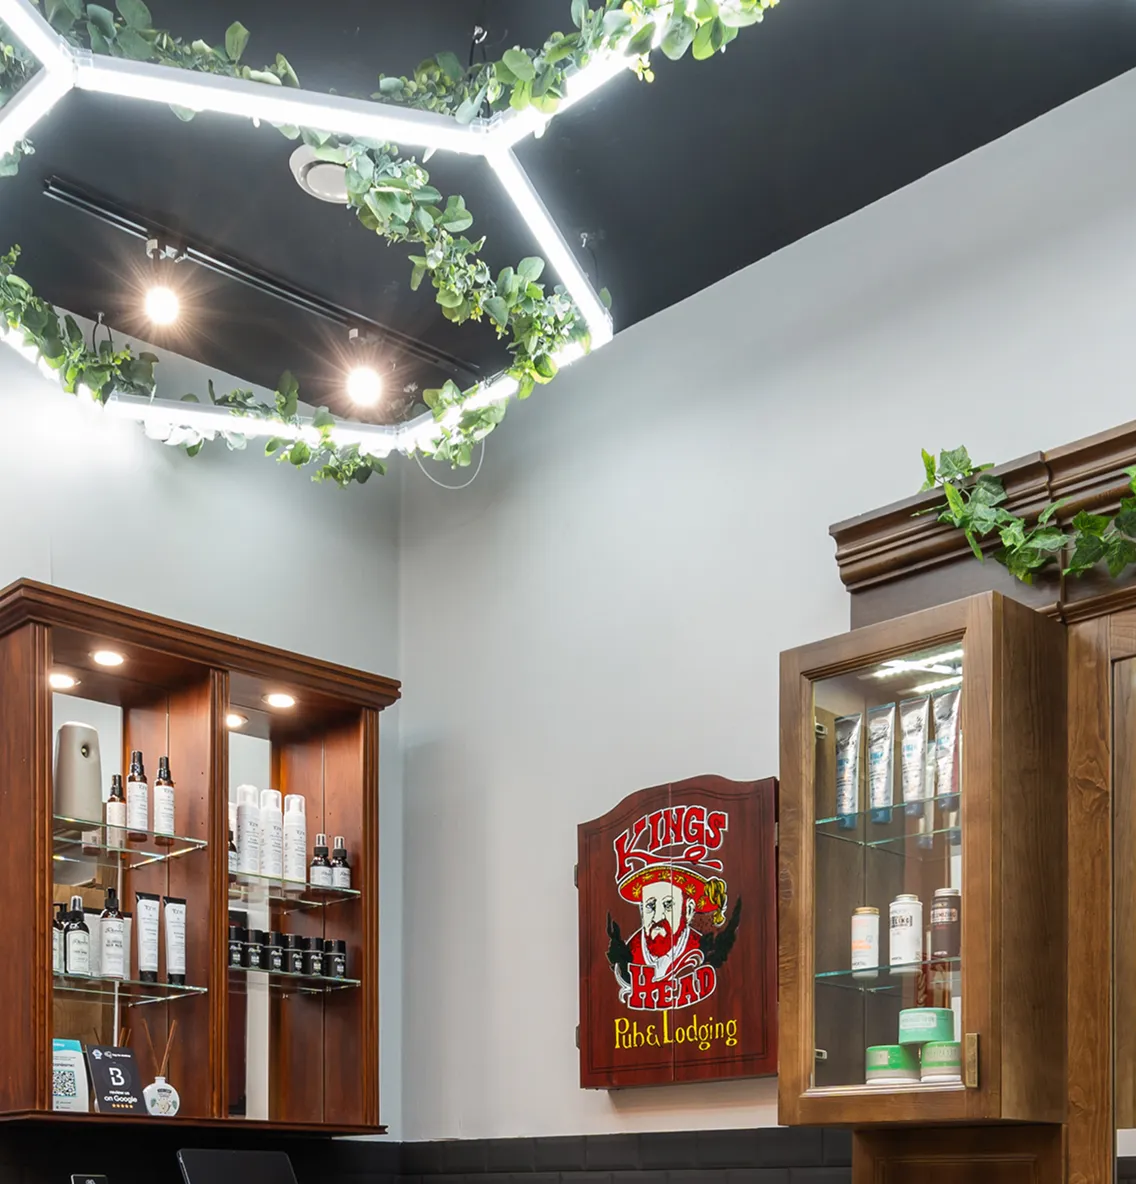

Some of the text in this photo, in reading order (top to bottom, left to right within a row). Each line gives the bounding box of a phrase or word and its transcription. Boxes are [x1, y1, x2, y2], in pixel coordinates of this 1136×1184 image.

[613, 804, 729, 881] KINGS
[627, 962, 717, 1011] HEAD
[662, 1010, 738, 1051] Lodging
[114, 1095, 138, 1103] Google
